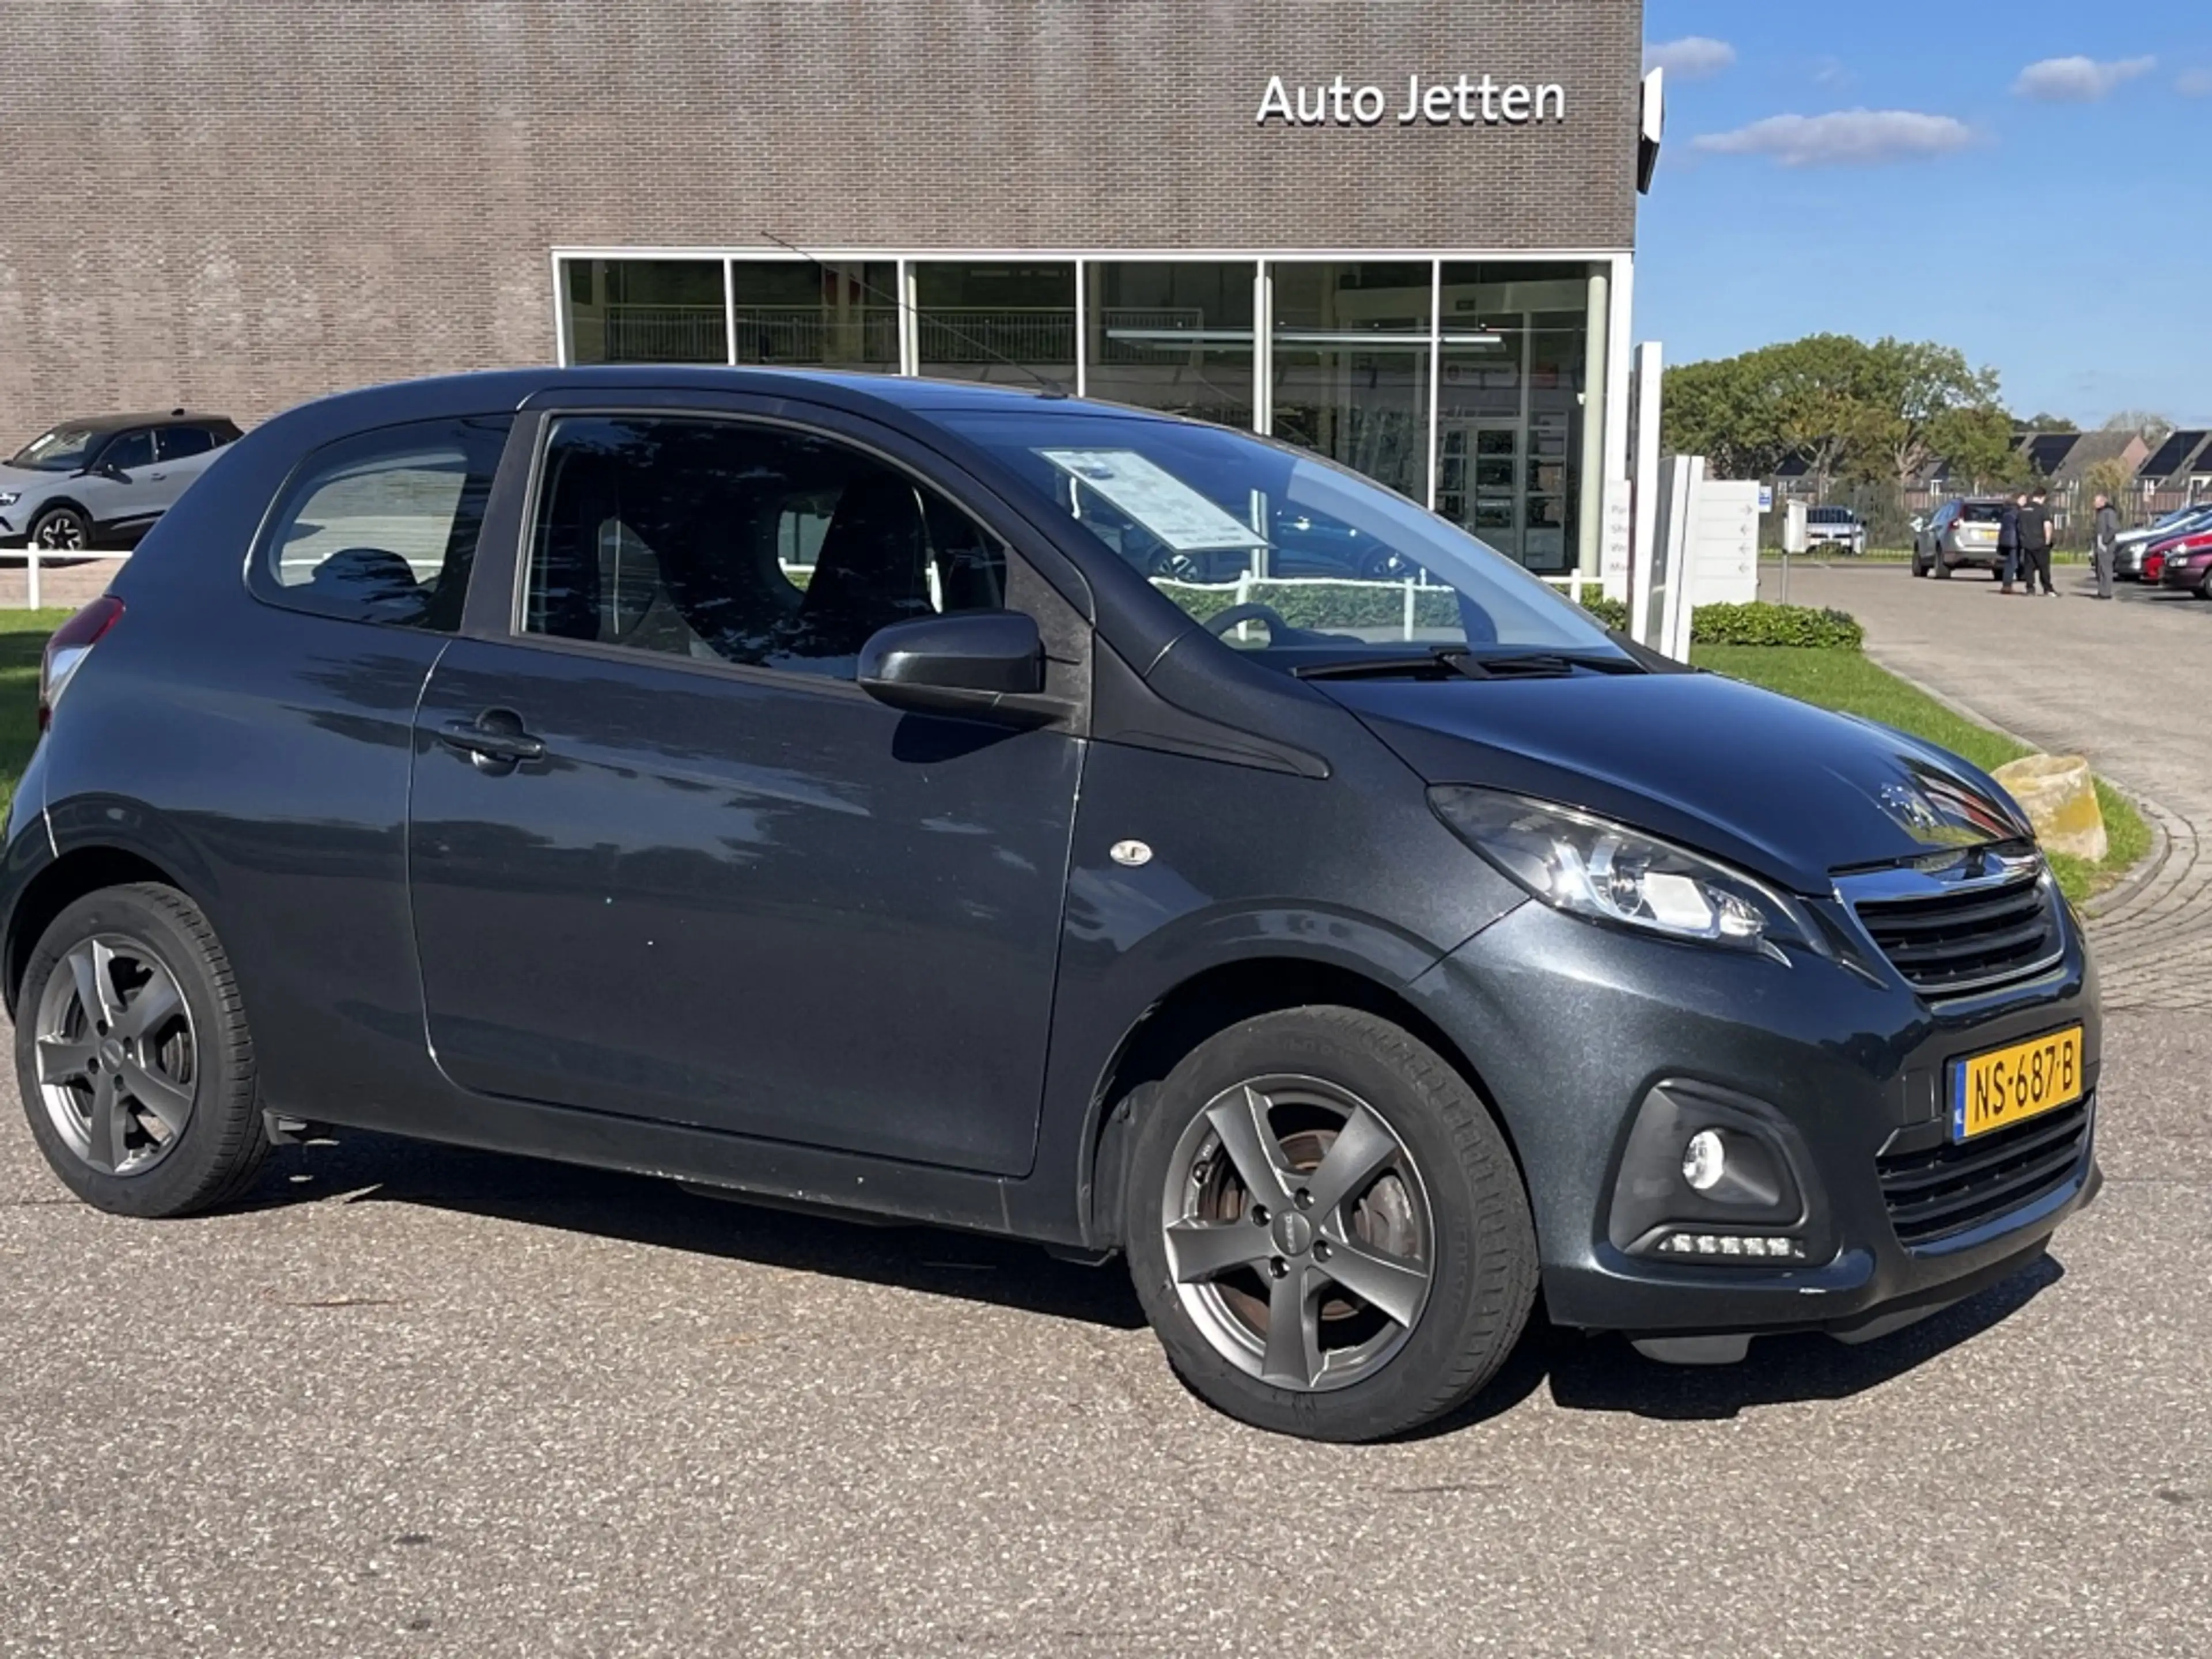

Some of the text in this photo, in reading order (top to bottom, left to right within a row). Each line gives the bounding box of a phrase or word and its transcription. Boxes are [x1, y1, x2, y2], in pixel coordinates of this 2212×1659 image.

[1255, 74, 1565, 123] Auto Jetten
[1975, 1040, 2073, 1123] NS-687-B
